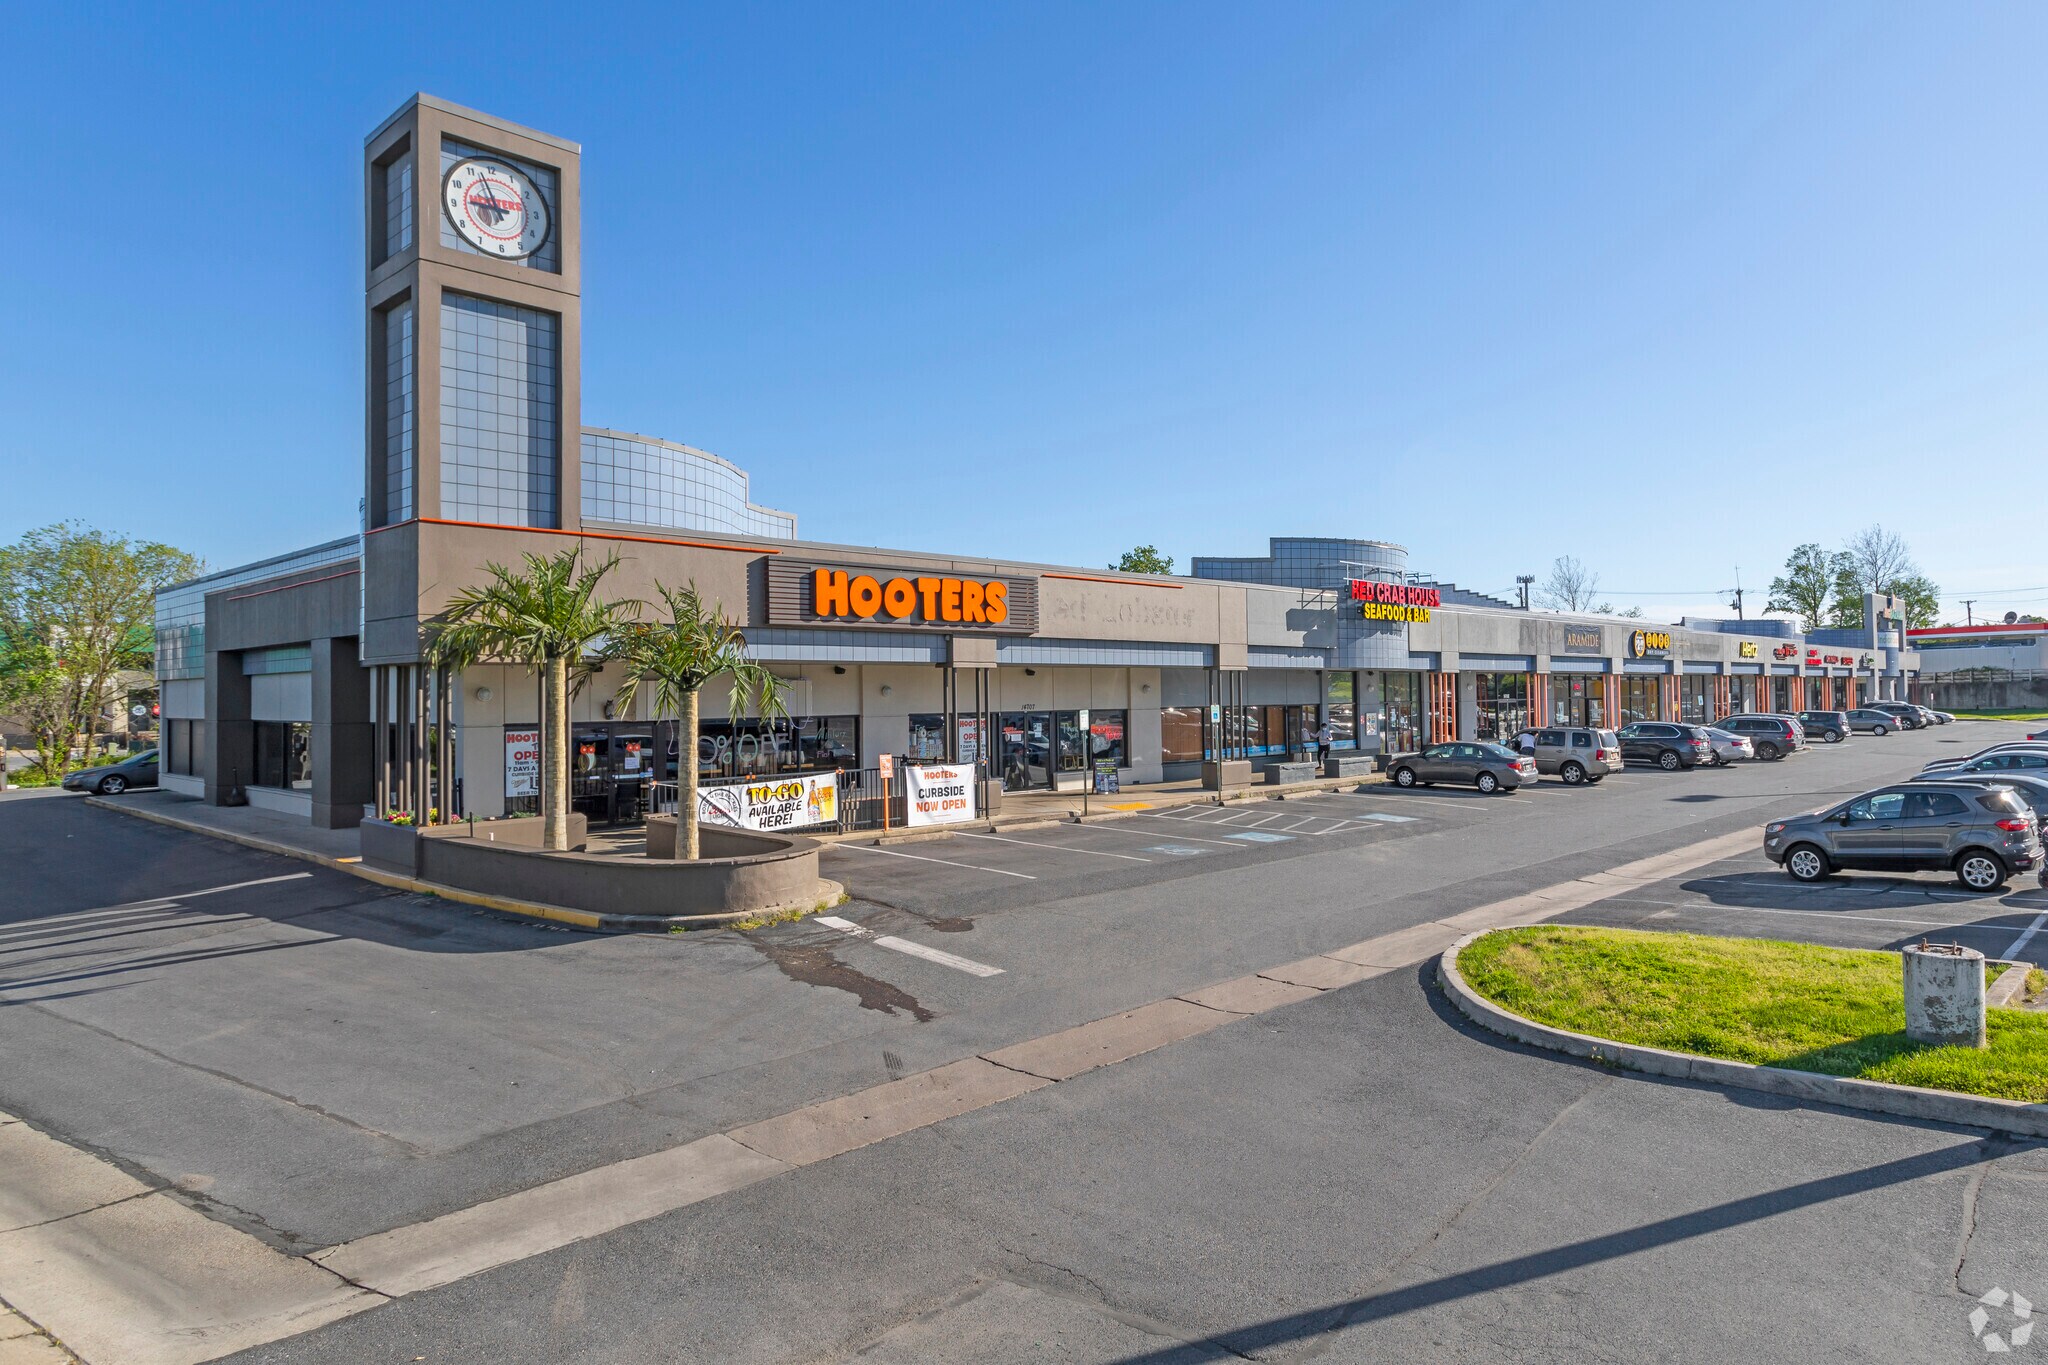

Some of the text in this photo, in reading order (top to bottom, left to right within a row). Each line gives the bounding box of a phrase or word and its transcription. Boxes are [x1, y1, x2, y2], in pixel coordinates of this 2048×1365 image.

[466, 167, 475, 176] 11
[487, 166, 496, 175] 12
[452, 179, 462, 189] 10
[509, 175, 514, 184] 1
[524, 191, 530, 200] 2
[451, 198, 457, 208] 9
[533, 211, 539, 220] 3
[459, 219, 466, 229] 8
[529, 229, 536, 239] 4
[478, 236, 483, 245] 7
[499, 244, 505, 253] 6
[517, 241, 524, 251] 5
[814, 567, 1008, 623] HOOTERS
[1351, 579, 1440, 607] RED CRAB HOUSE
[1364, 603, 1431, 623] SEAFOOD & BAR
[1567, 633, 1599, 647] ARAMIDE
[1742, 642, 1758, 657] Hertz
[514, 751, 538, 760] OPE
[747, 782, 804, 805] TO-GO
[918, 785, 964, 799] CURBSIDE
[749, 801, 801, 817] AVAILABLE
[916, 798, 966, 812] NOW OPEN
[759, 813, 793, 828] HERE!
